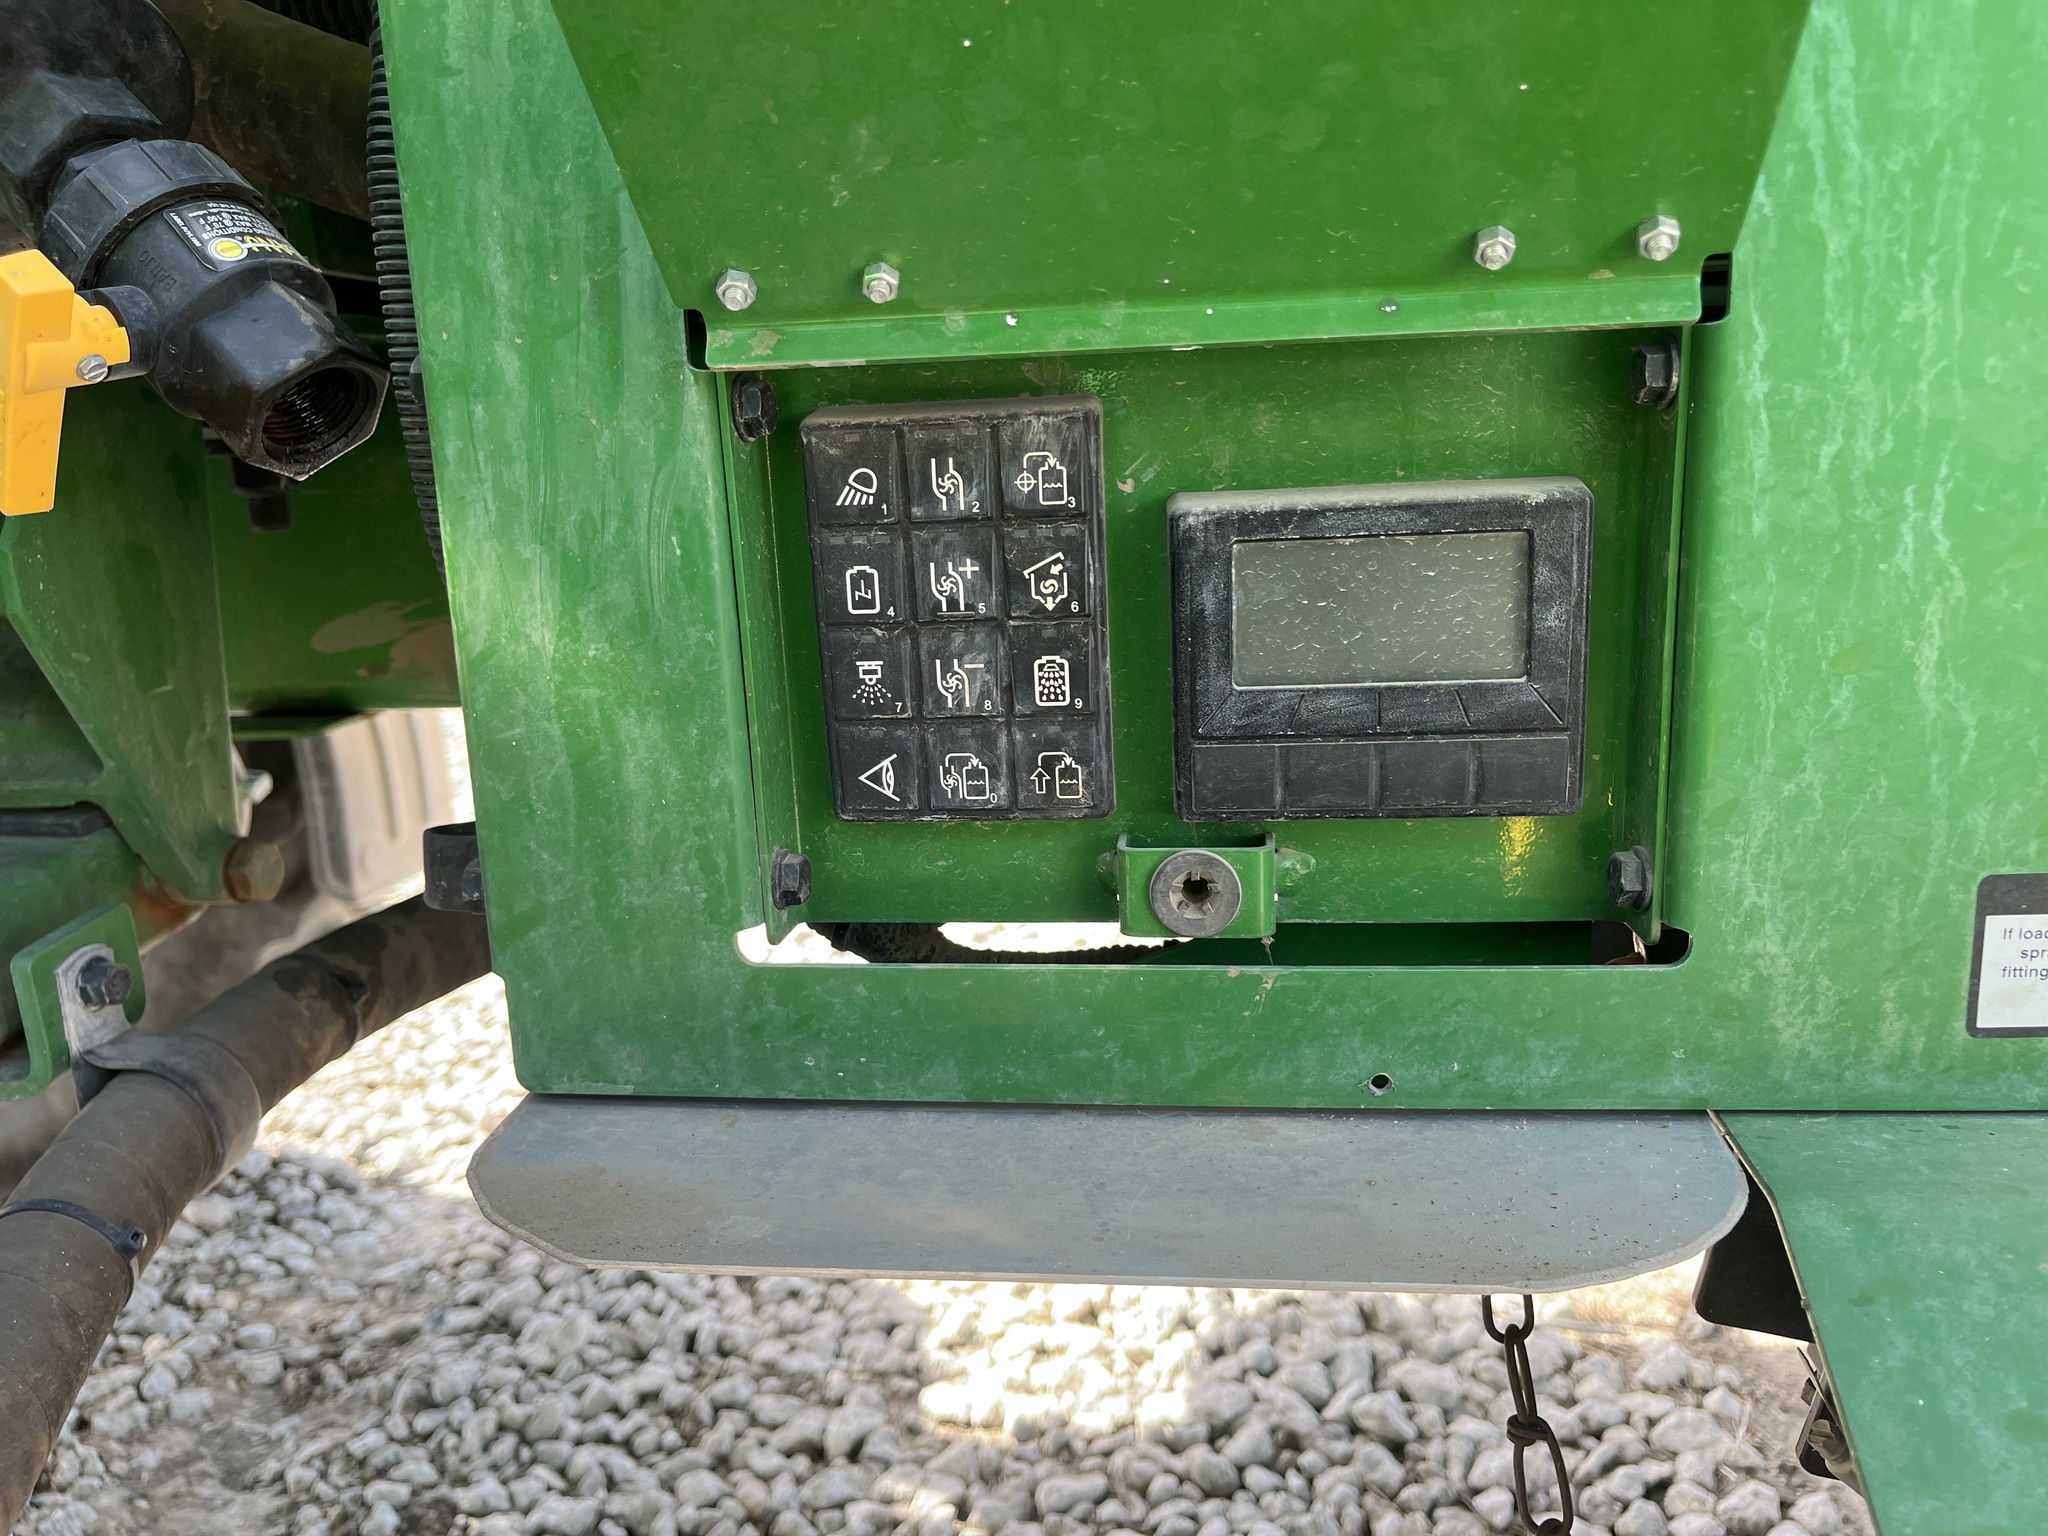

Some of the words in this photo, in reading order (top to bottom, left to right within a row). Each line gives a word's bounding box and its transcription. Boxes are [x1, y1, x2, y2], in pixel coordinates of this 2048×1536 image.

[201, 226, 253, 240] CONDITIONS
[139, 250, 178, 292] BANJO
[971, 501, 981, 513] 2
[1067, 496, 1077, 508] 3
[881, 503, 888, 516] 1
[886, 606, 896, 617] 4
[978, 602, 986, 614] 5
[1070, 601, 1079, 613] 6
[895, 702, 903, 713] 7
[983, 699, 993, 711] 8
[1074, 697, 1083, 710] 9
[990, 792, 998, 804] 0
[2003, 928, 2014, 940] If
[2020, 949, 2048, 961] spr
[2002, 966, 2048, 981] fitting
